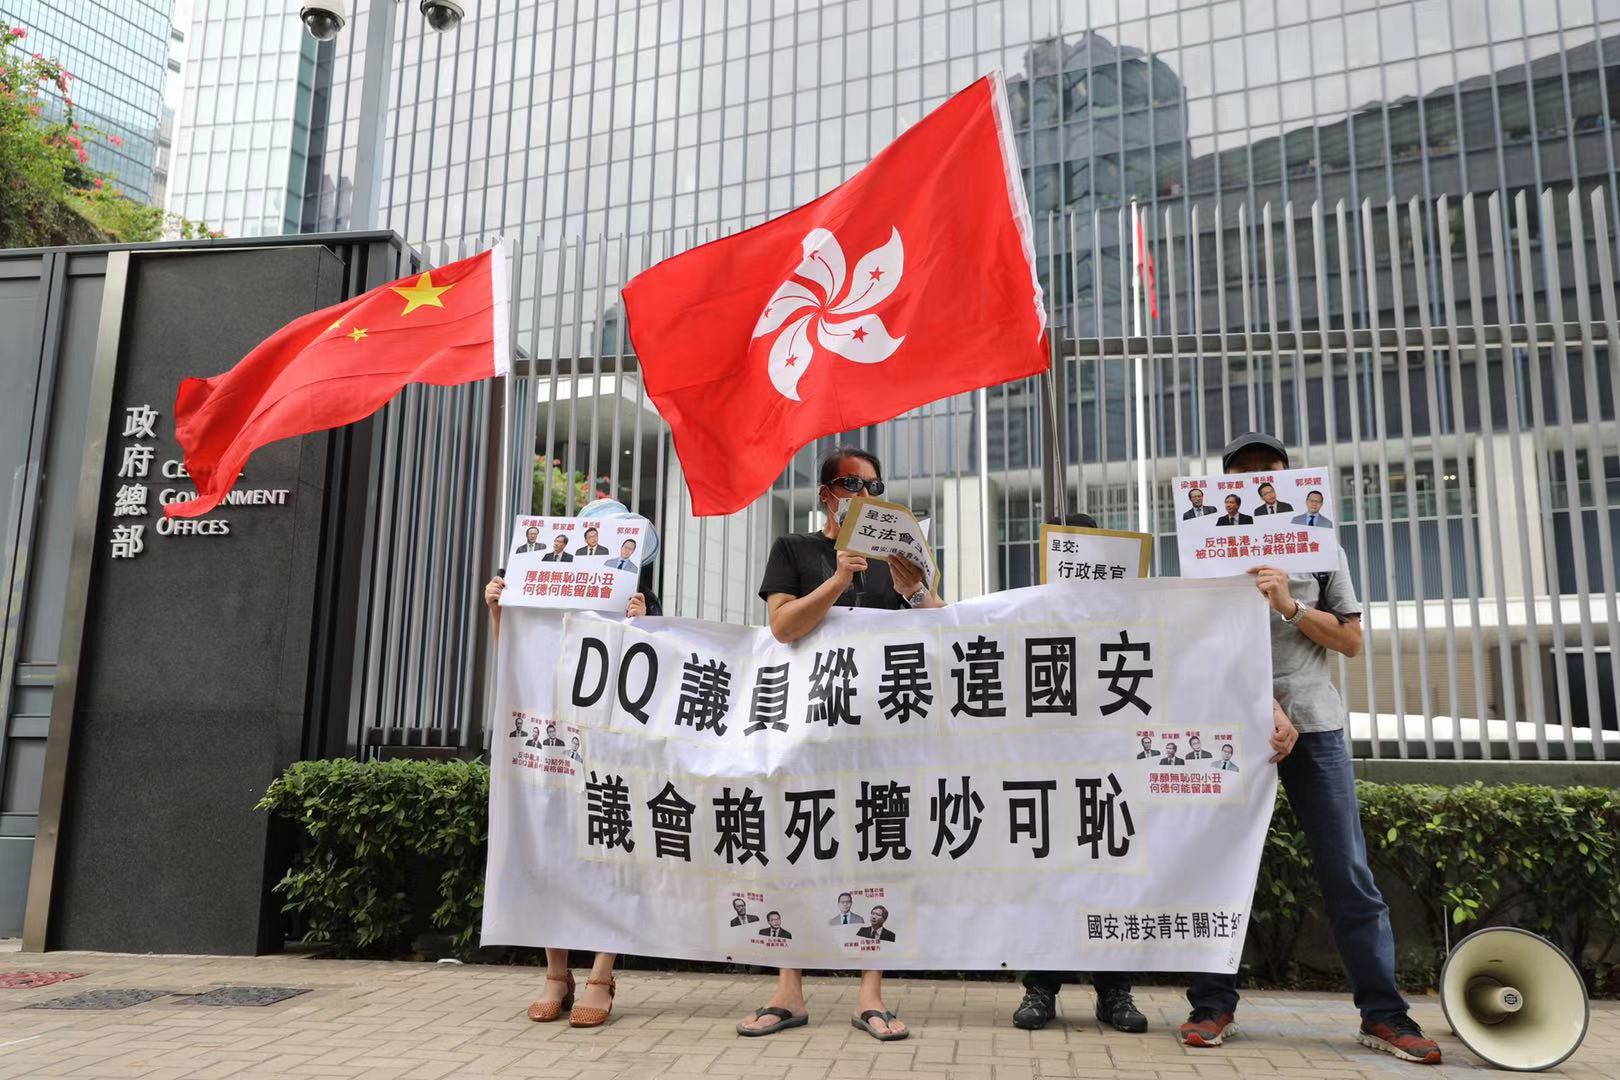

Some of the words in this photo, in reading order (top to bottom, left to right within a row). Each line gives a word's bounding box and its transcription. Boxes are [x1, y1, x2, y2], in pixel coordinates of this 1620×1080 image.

[110, 404, 159, 559] 政府總部
[159, 488, 289, 507] GOVNMENT
[156, 516, 230, 536] OFFICES
[1051, 539, 1079, 553] 呈交:
[1205, 531, 1308, 548] 反中亂港，勾結外國
[1195, 542, 1320, 560] 被DQ議員冇資格留議會
[1058, 560, 1126, 580] 行政長官
[522, 583, 613, 599] 何德何能留議會
